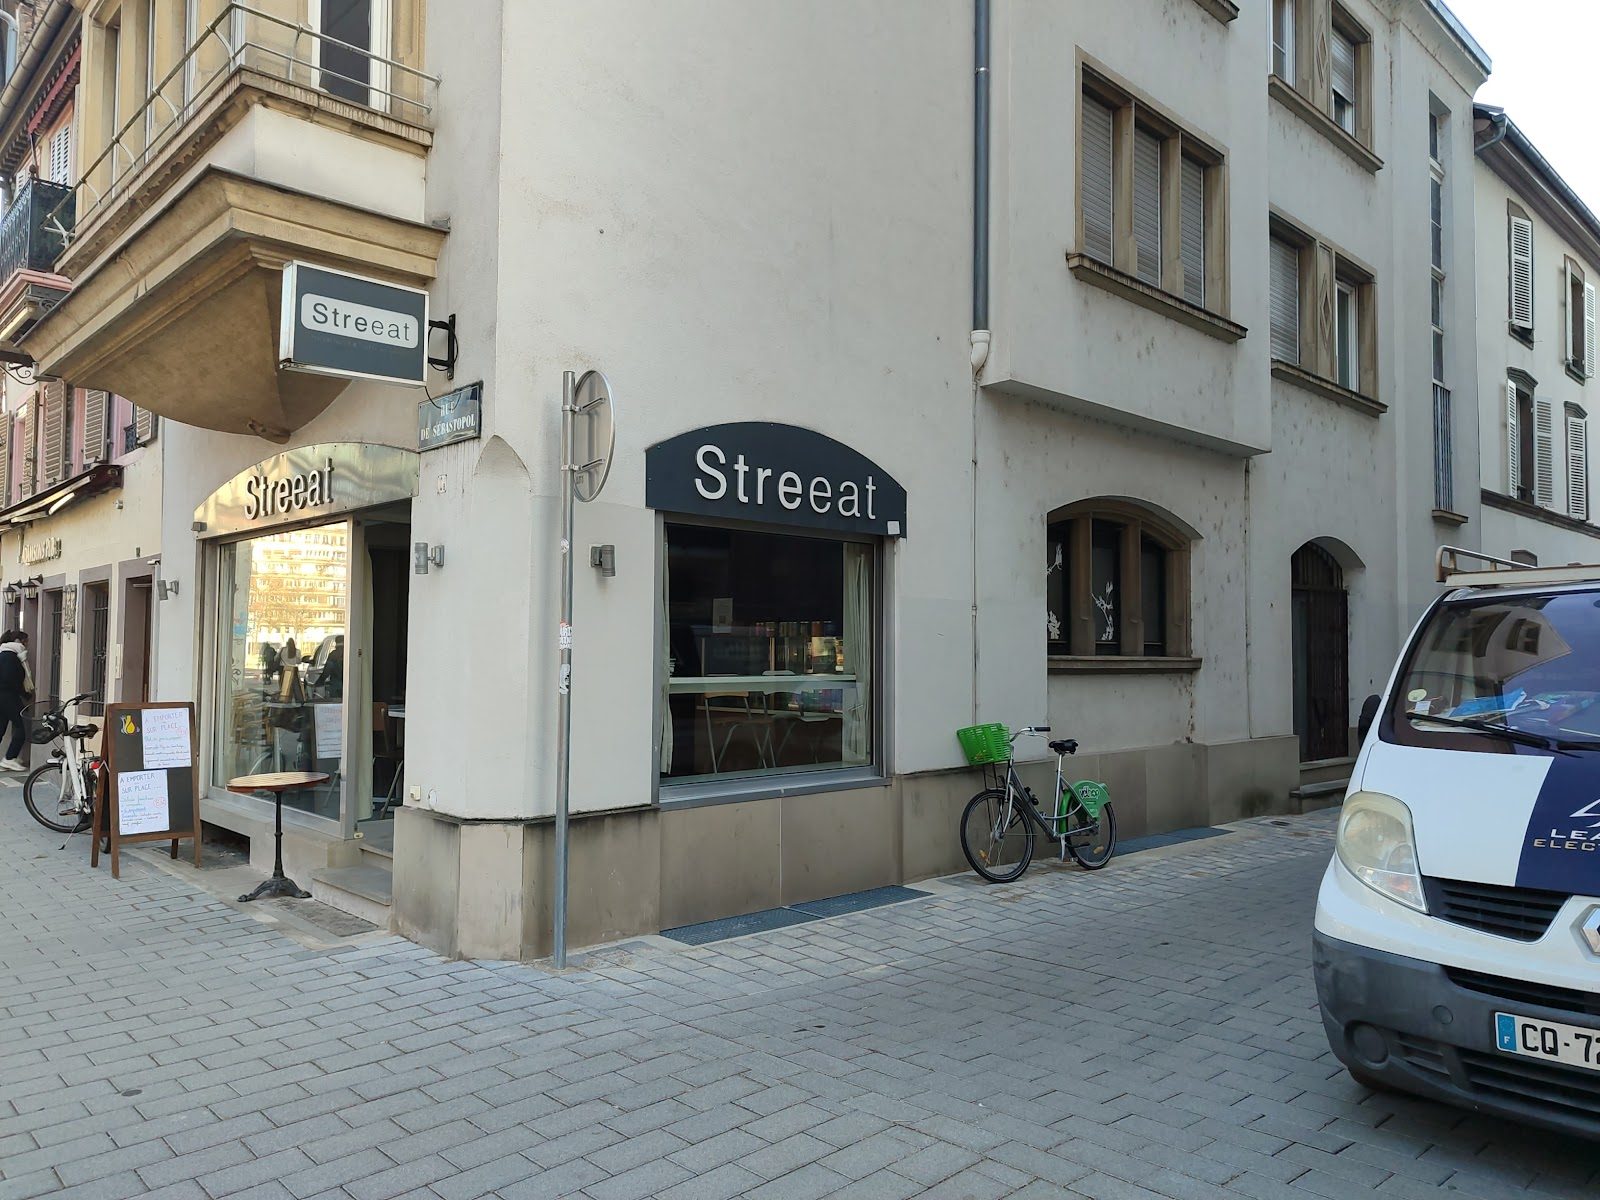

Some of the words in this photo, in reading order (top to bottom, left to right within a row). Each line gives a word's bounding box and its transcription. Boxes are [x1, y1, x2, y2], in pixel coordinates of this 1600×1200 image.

[312, 302, 410, 341] Streeat
[440, 401, 455, 417] RUE
[420, 427, 430, 441] DE
[244, 457, 334, 520] Streeat
[694, 444, 877, 520] Streeat
[120, 776, 125, 784] A
[126, 772, 156, 783] EMPORTER
[121, 786, 133, 794] SUR
[134, 783, 152, 792] PLACE
[1503, 1036, 1511, 1045] F
